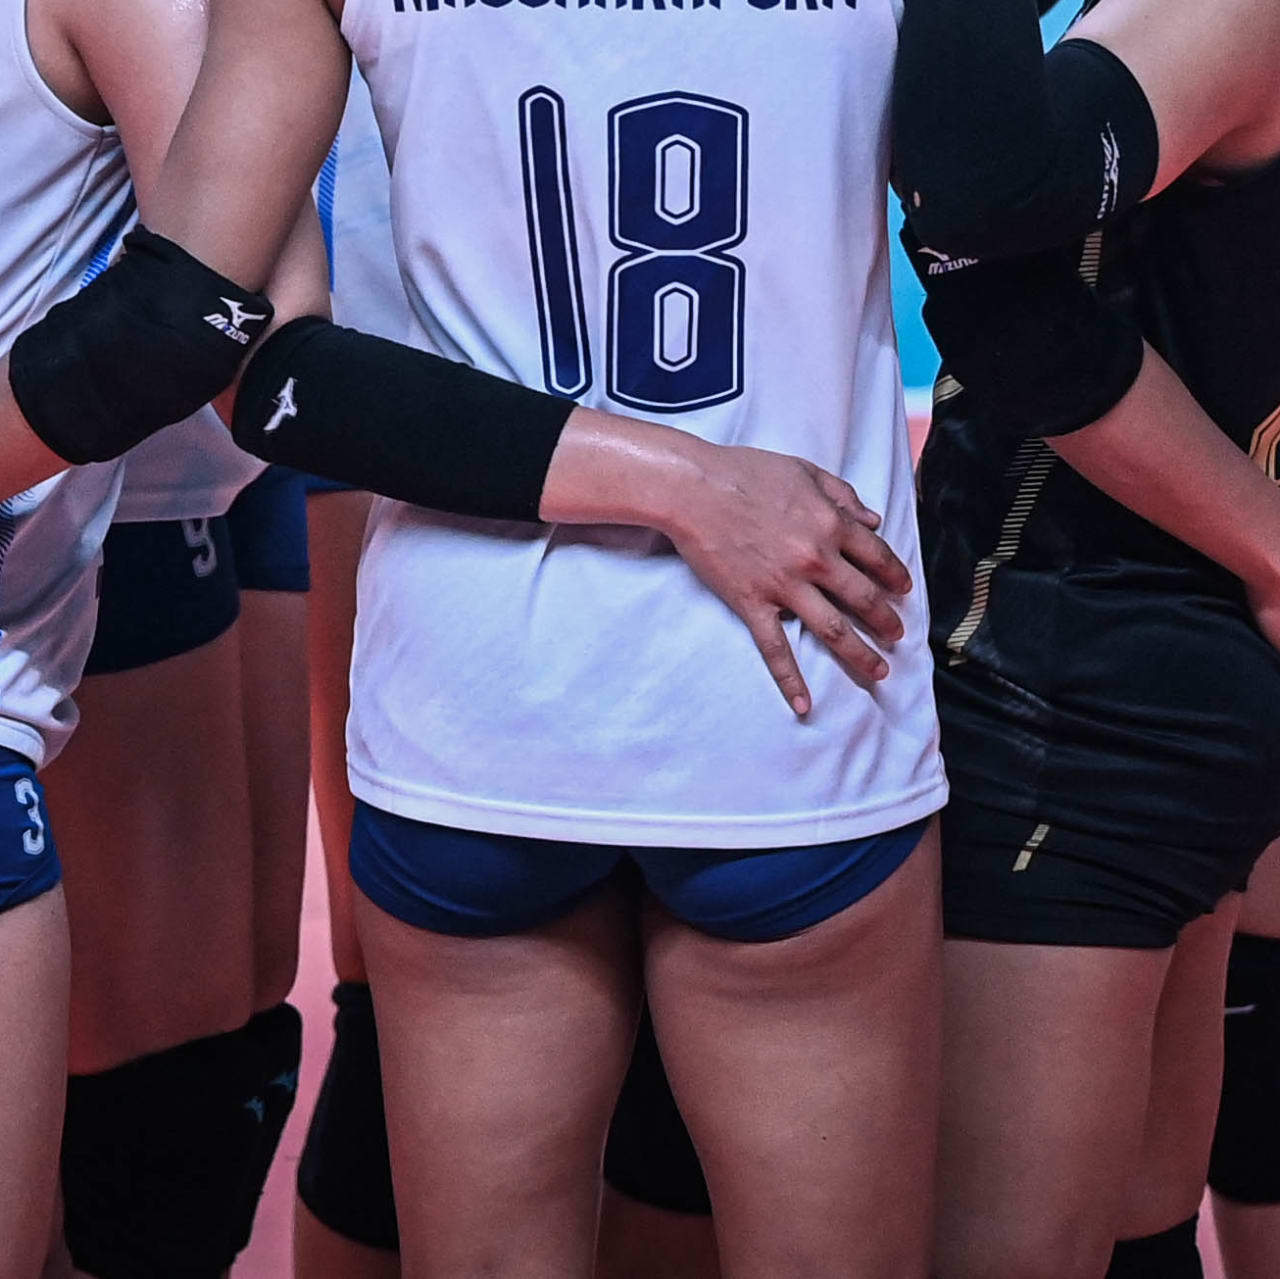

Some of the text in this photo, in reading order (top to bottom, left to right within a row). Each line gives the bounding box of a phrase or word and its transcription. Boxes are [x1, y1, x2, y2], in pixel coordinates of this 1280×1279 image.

[518, 85, 749, 414] 18
[181, 519, 218, 578] 9
[14, 778, 45, 855] 3
